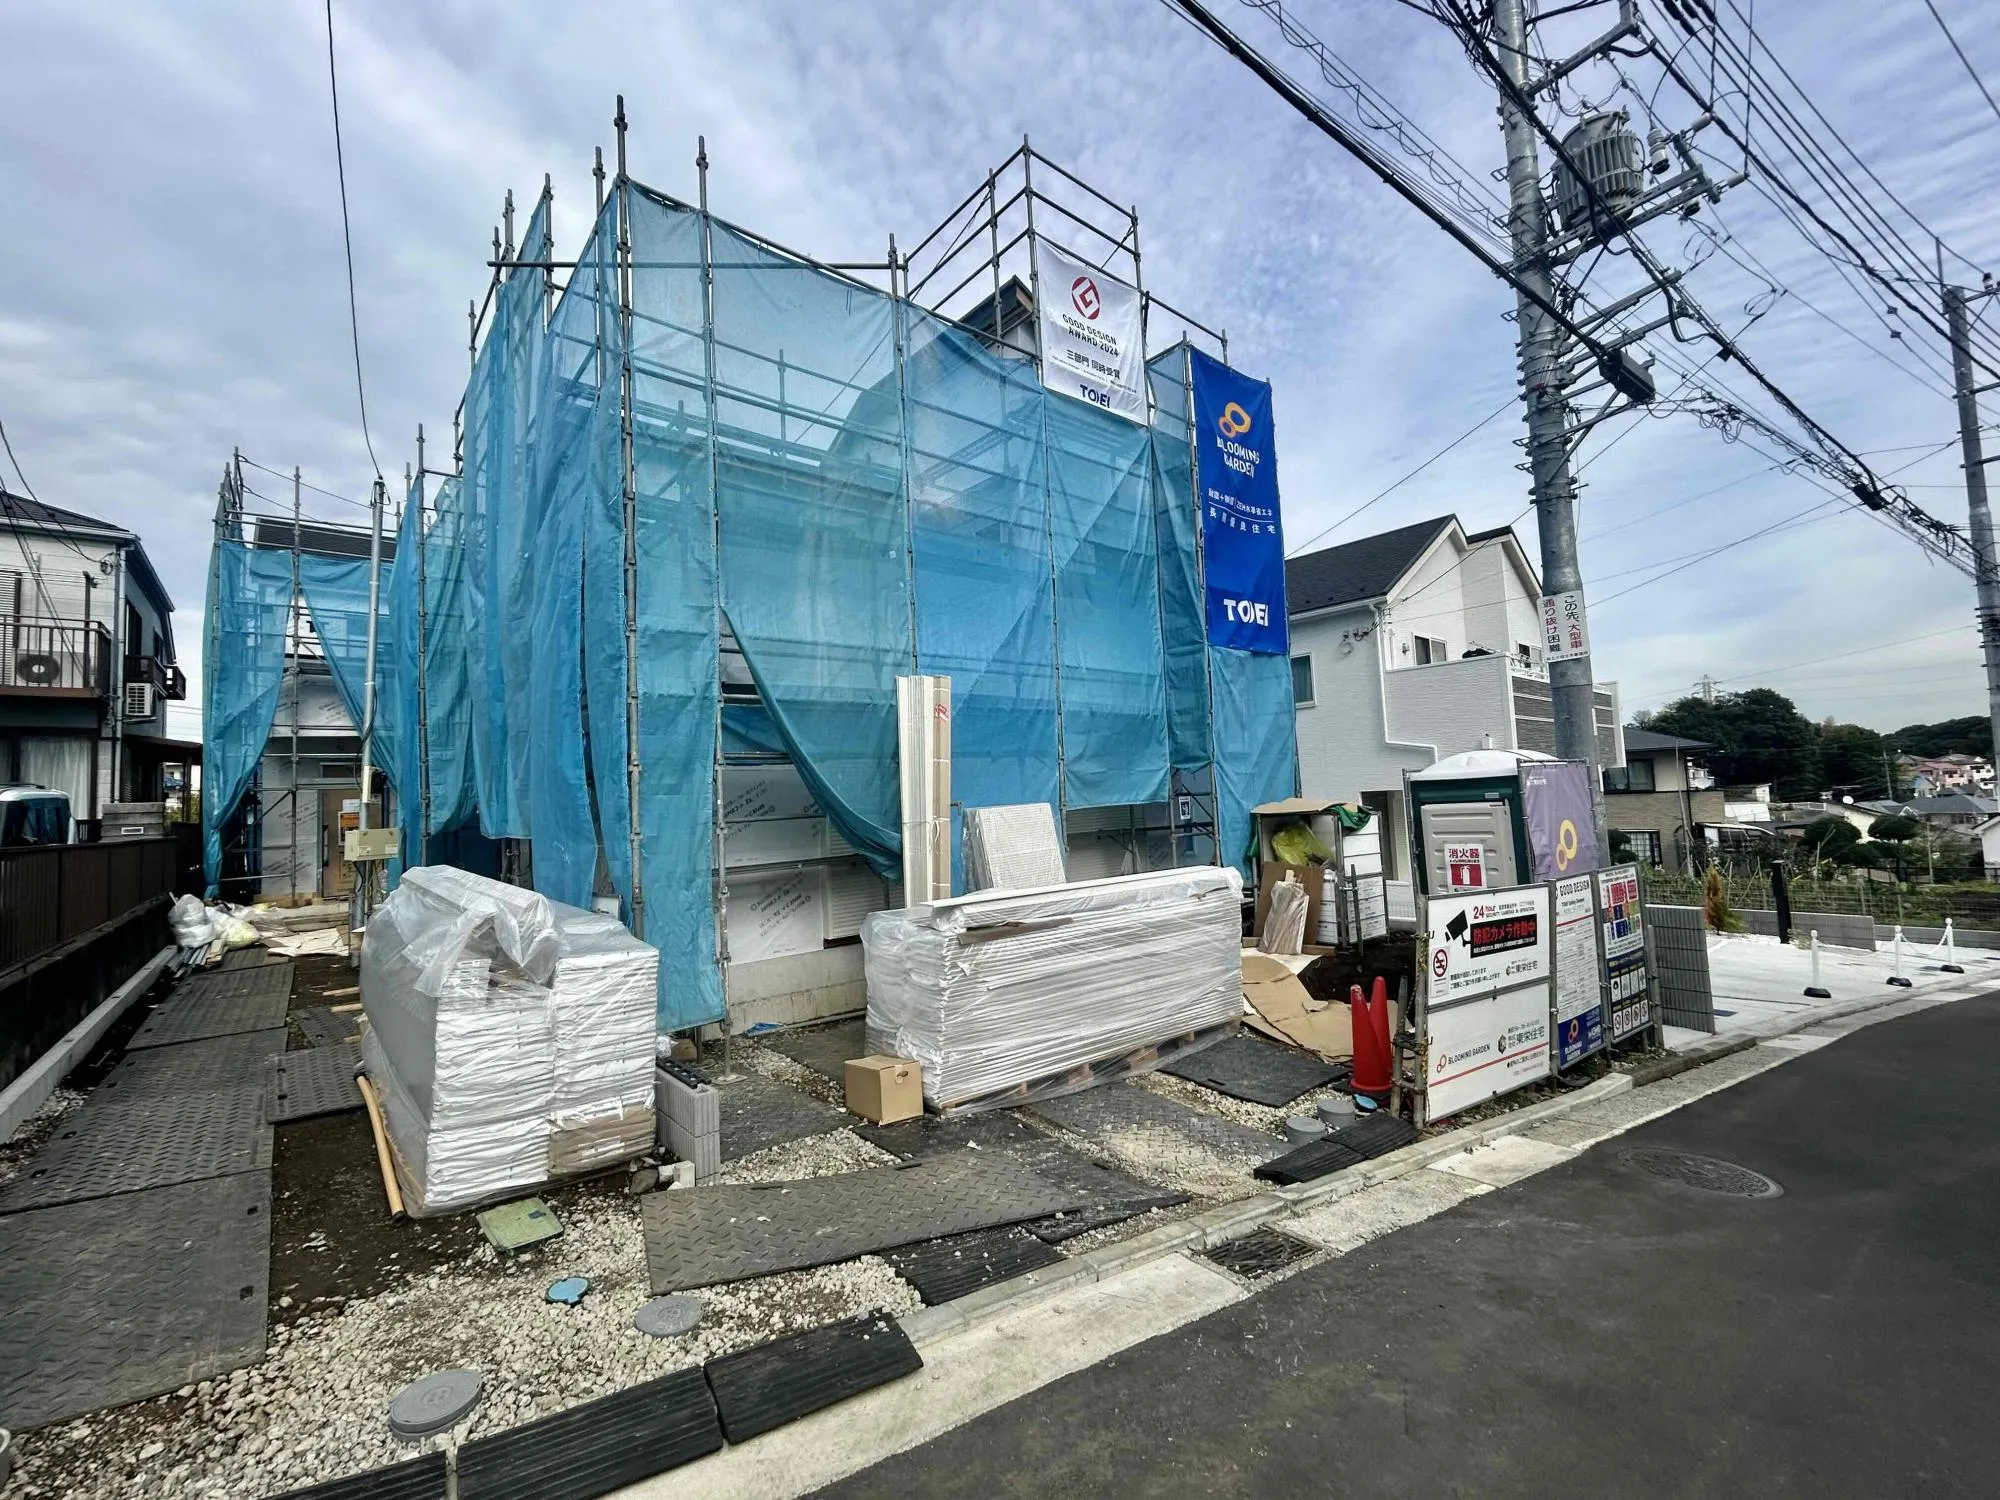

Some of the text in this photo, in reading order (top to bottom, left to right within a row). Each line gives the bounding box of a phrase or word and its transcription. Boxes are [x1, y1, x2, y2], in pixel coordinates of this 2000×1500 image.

[1063, 314, 1117, 345] GOOD DESIGN
[1069, 327, 1119, 357] AWARD 2024
[1217, 435, 1260, 464] BLOOMING
[1224, 453, 1255, 478] GARDEN
[1542, 598, 1561, 652] 通り抜け困難
[1448, 848, 1480, 859] 消火器
[1559, 879, 1589, 896] GOOD DESIGN
[1473, 905, 1485, 919] 24
[1473, 920, 1536, 945] 防犯カメラ作動中
[1448, 1043, 1490, 1065] BLOOMING GARDEN
